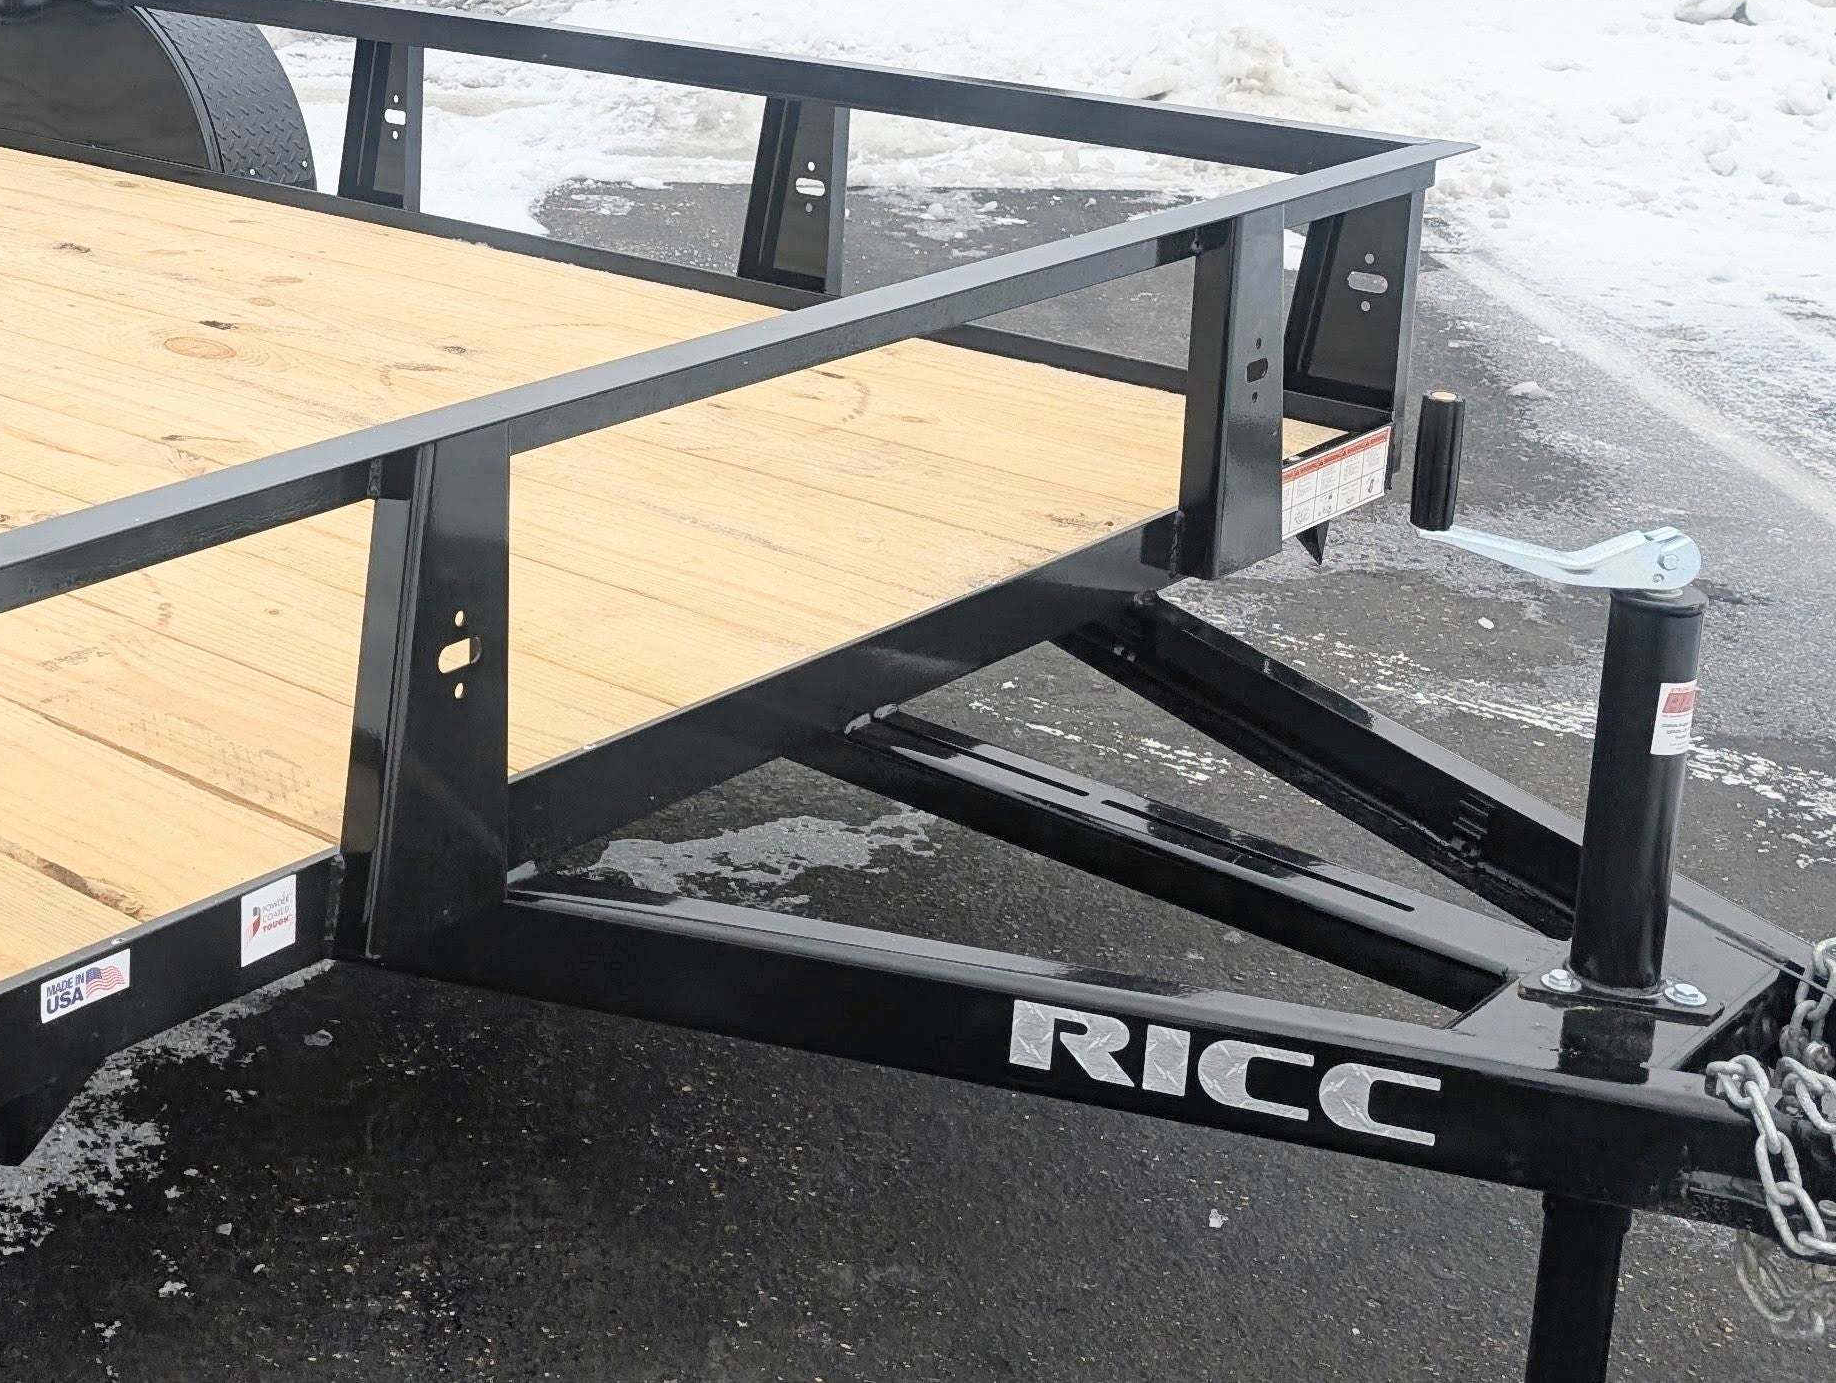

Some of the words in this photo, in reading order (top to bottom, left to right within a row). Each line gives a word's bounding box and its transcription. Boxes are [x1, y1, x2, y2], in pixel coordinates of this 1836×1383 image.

[262, 905, 290, 923] COATED
[46, 976, 74, 997] MADE
[74, 972, 85, 986] IN
[46, 986, 84, 1015] USA
[1009, 999, 1442, 1146] RICC
